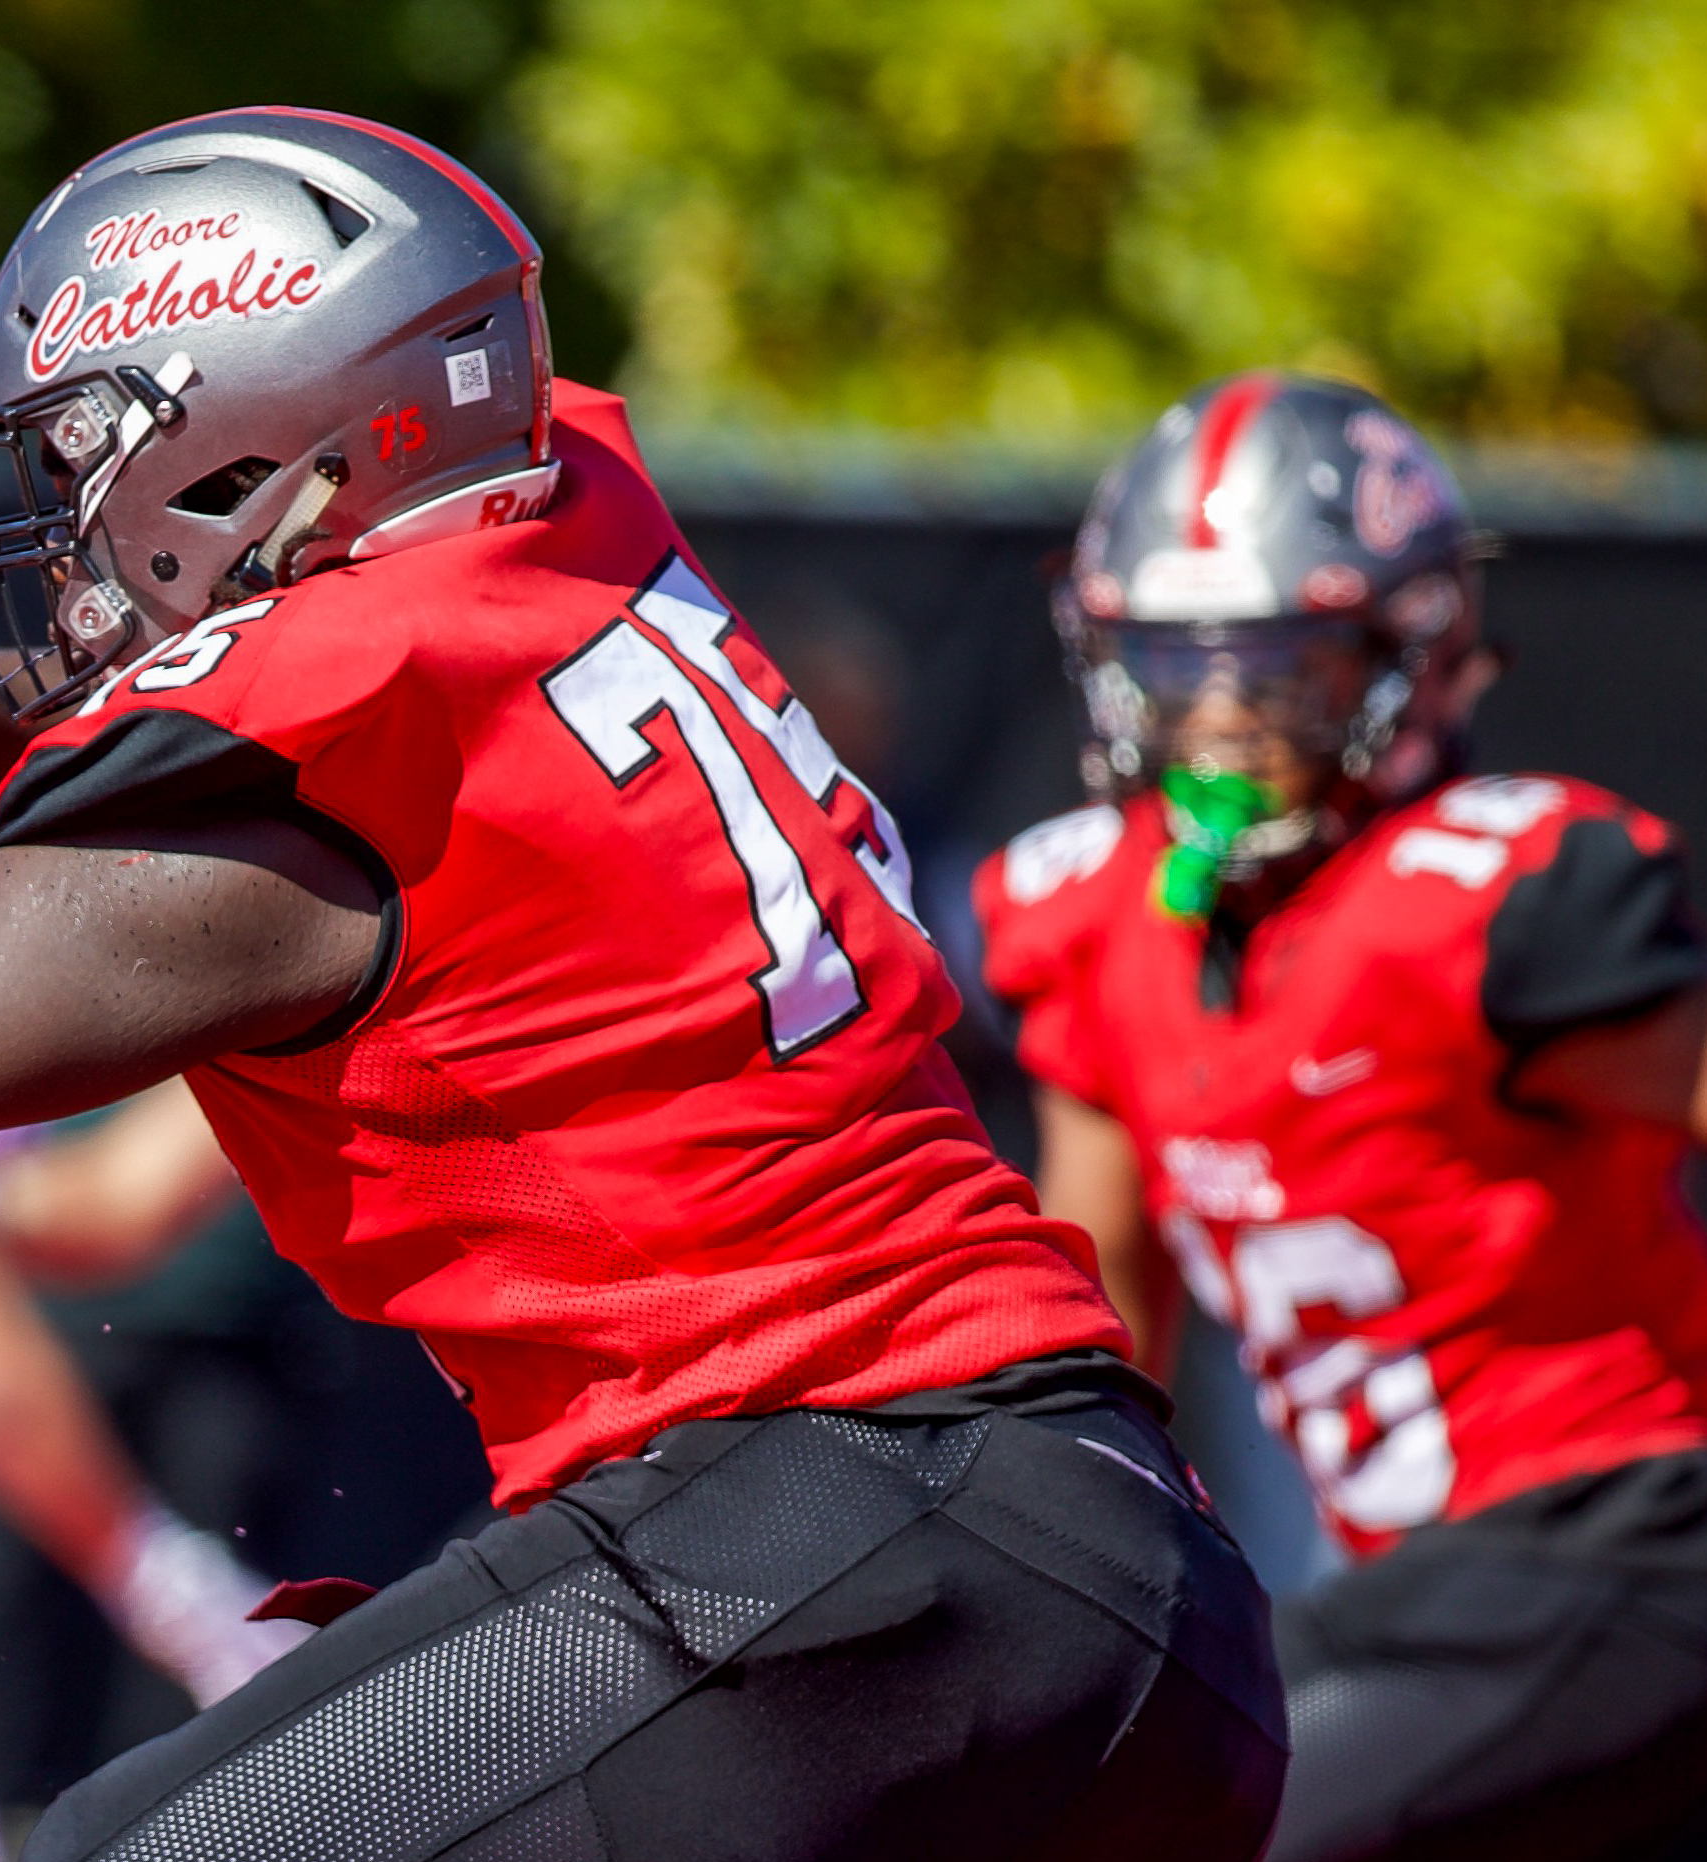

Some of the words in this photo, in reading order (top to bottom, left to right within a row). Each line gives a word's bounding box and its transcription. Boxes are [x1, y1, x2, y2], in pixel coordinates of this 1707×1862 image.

[90, 212, 240, 266] Moore
[31, 248, 322, 376] Catholic
[370, 405, 427, 461] 75
[537, 545, 935, 1065] 75
